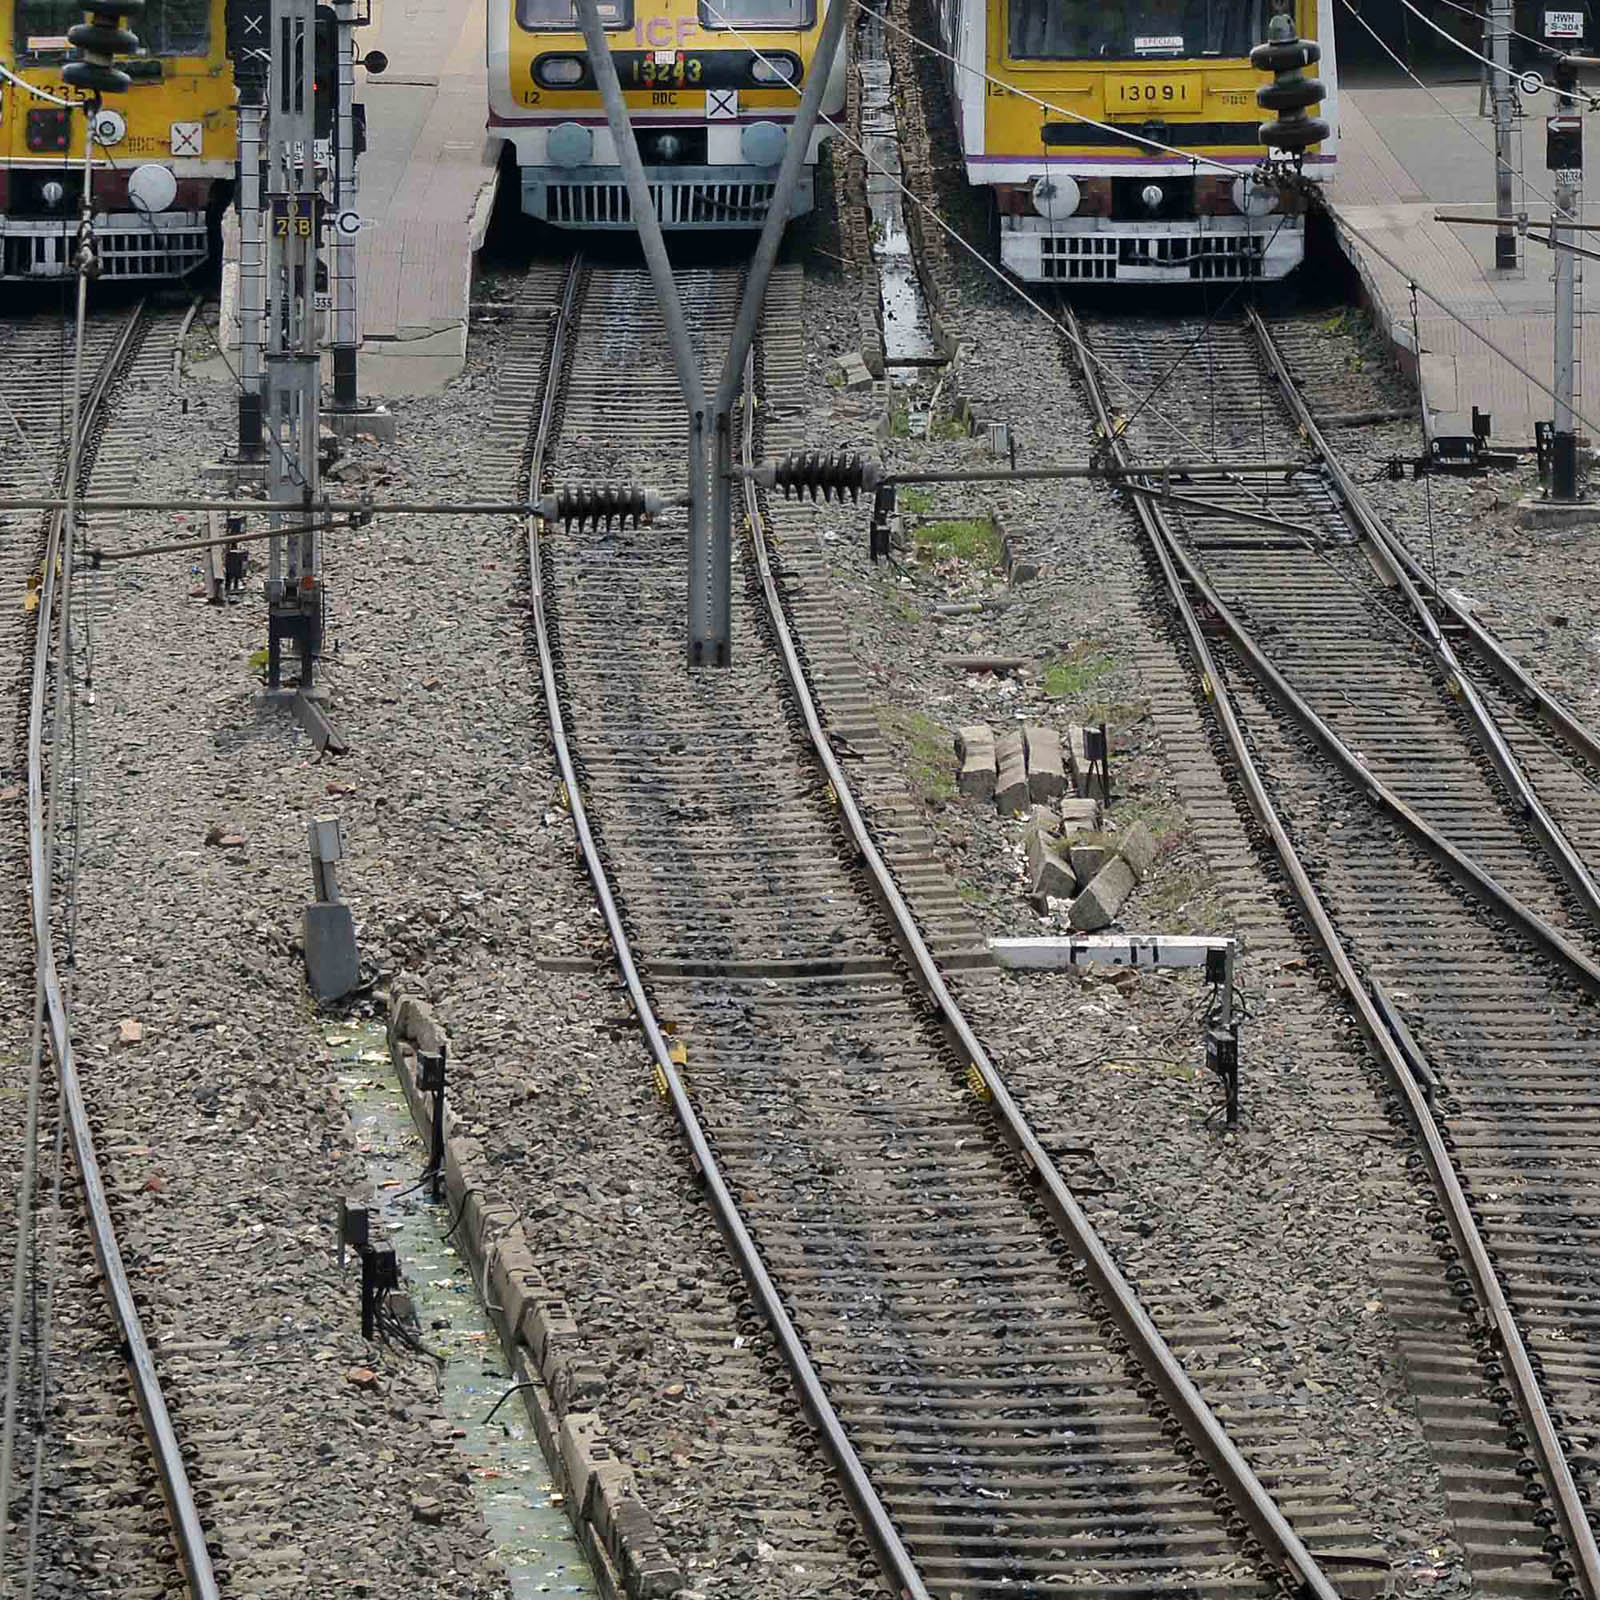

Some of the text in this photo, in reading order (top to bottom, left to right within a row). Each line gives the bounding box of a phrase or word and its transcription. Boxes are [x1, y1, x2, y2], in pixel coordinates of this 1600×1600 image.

[1553, 14, 1575, 22] HWH
[635, 17, 697, 48] ICF
[632, 58, 703, 82] 13243
[524, 91, 541, 105] 12
[1119, 84, 1187, 101] 13091
